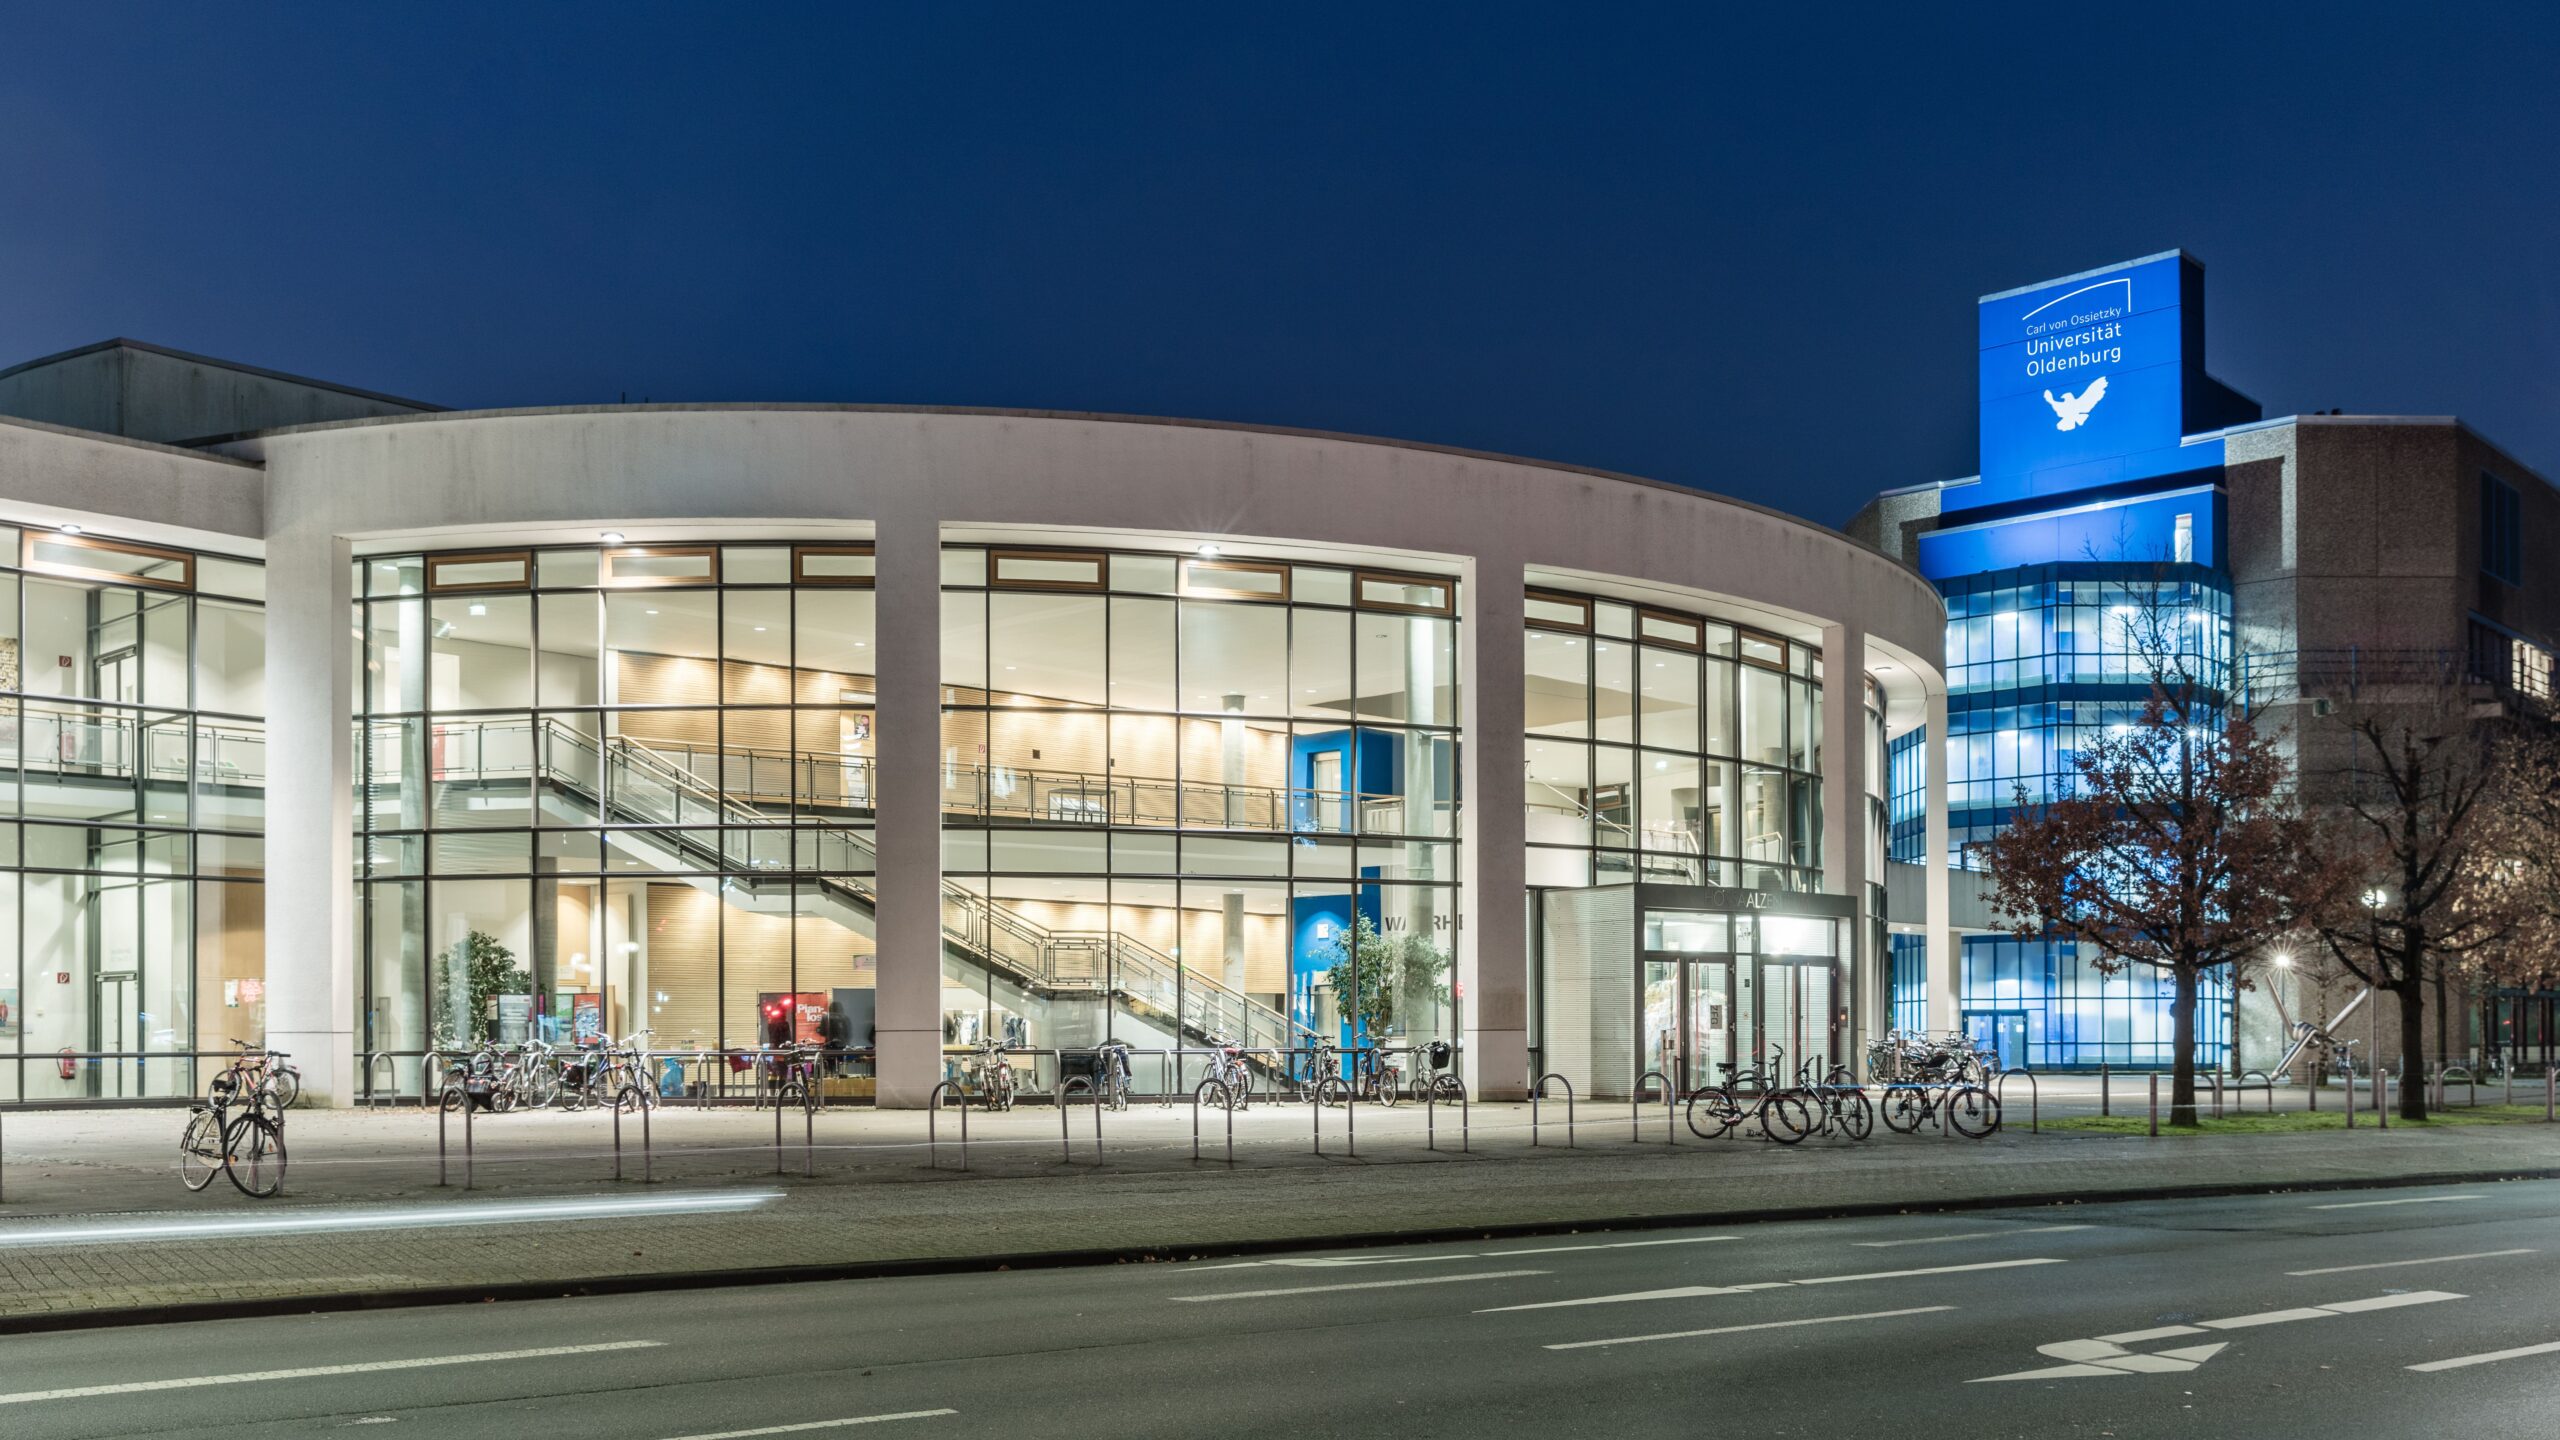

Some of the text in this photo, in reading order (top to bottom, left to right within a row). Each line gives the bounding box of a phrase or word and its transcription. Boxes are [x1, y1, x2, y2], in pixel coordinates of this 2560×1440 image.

[2026, 306, 2122, 337] Carl von Ossietzky
[2026, 322, 2122, 356] Universität
[2026, 346, 2121, 377] Oldenburg
[1711, 1005, 1719, 1025] ZFG
